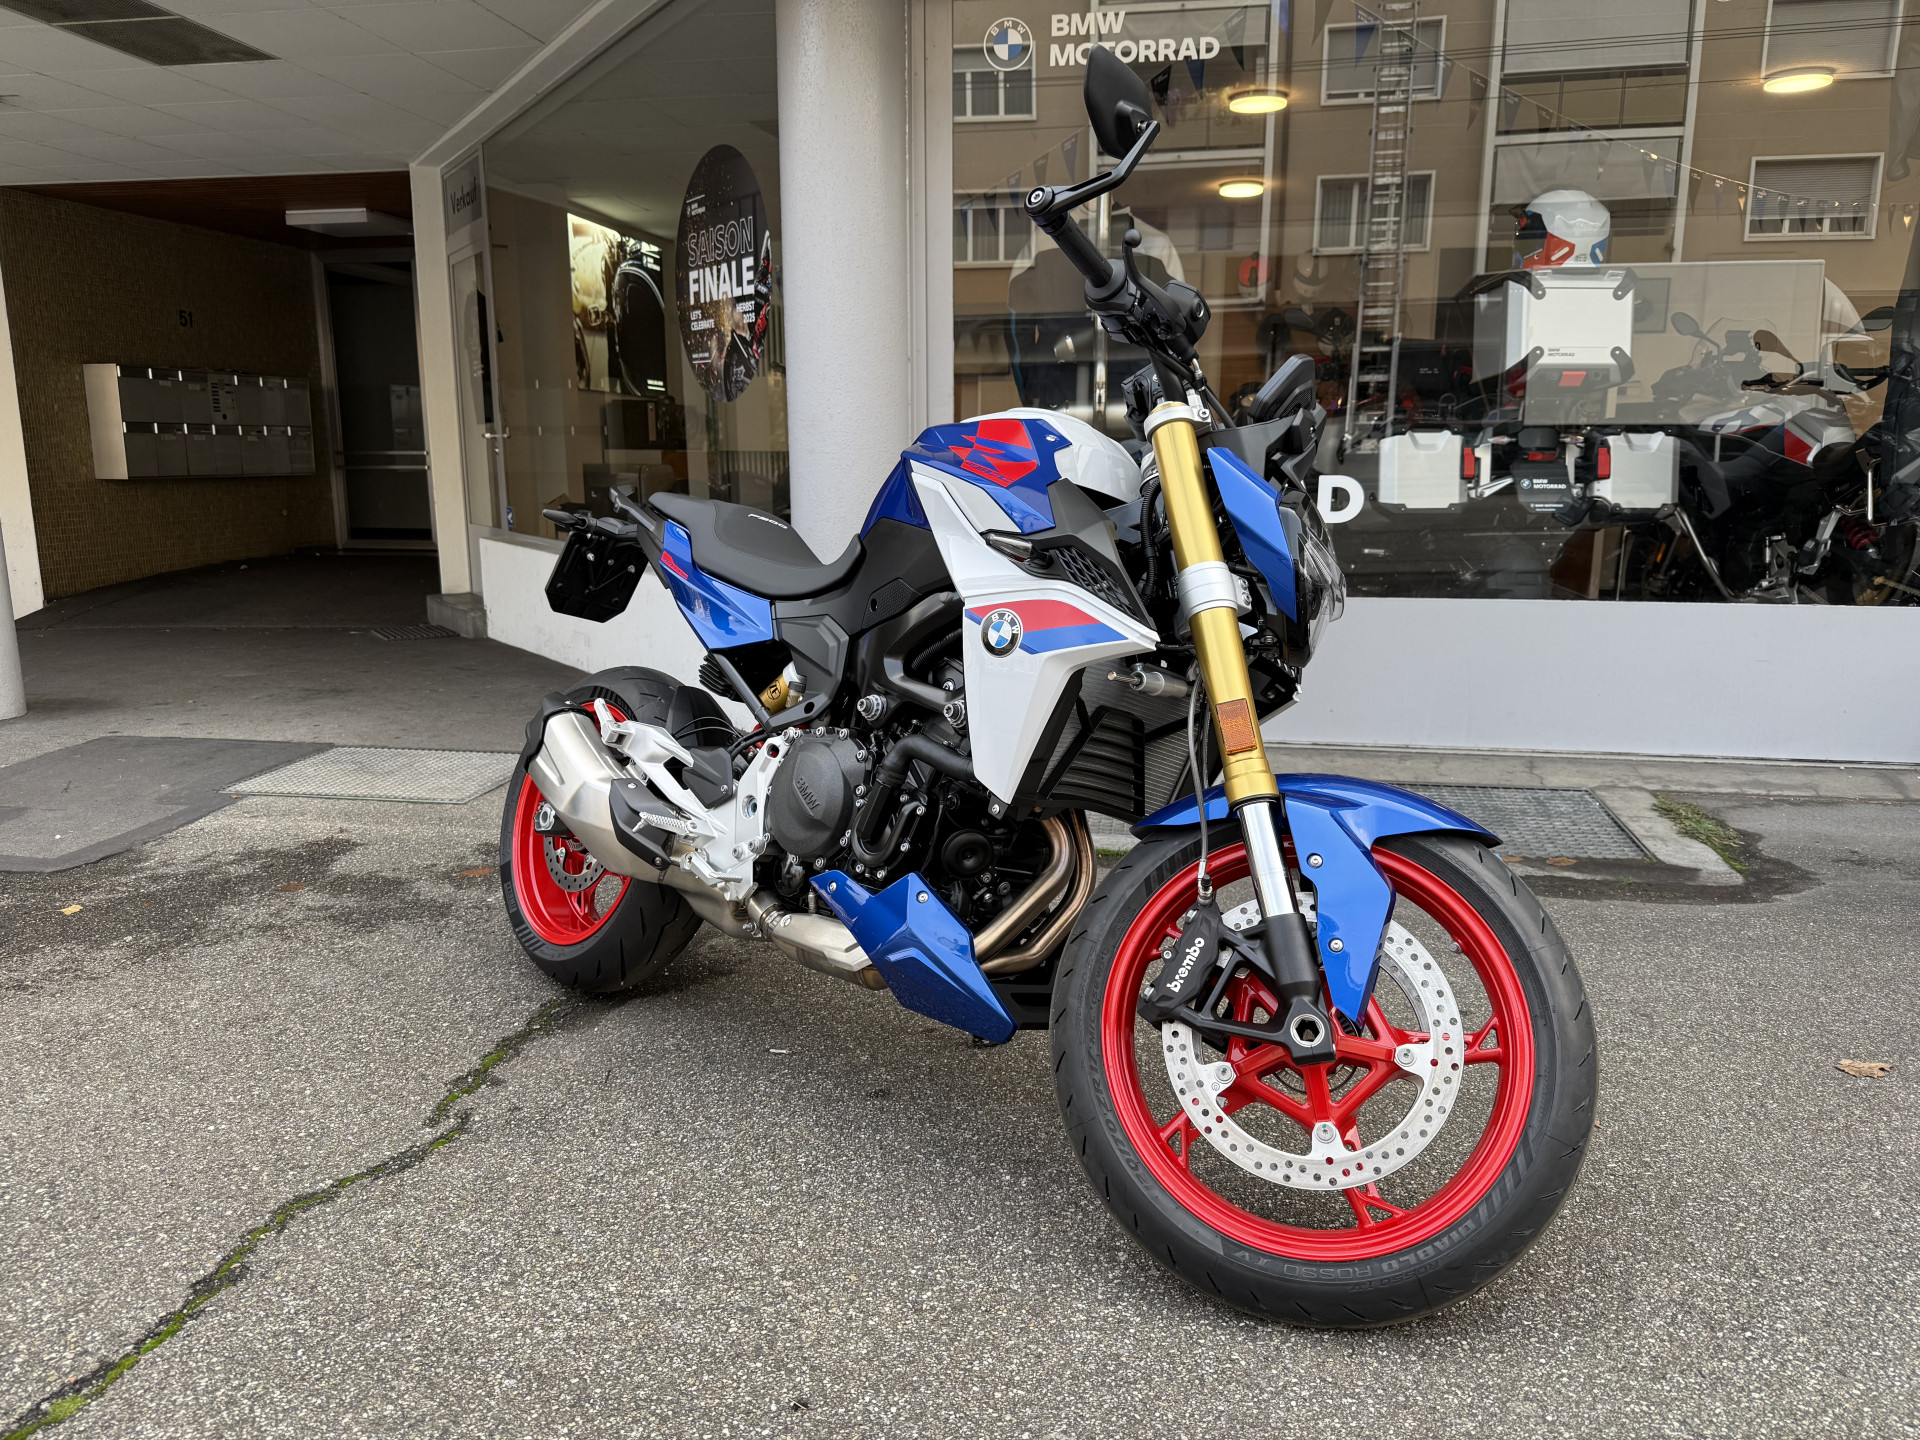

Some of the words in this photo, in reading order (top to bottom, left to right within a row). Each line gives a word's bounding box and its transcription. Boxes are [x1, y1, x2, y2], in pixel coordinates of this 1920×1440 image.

[991, 20, 1026, 37] BMW
[1051, 11, 1125, 37] BMW
[450, 176, 477, 215] Verkauf
[688, 216, 754, 267] SAISON
[688, 256, 755, 306] FINALE
[179, 309, 193, 328] 51
[736, 301, 756, 313] HERBST
[743, 312, 756, 324] 2025
[691, 318, 715, 332] CELEBRATE
[1317, 474, 1365, 523] D
[991, 612, 1020, 634] BMW
[796, 776, 820, 811] BMW
[1166, 937, 1205, 993] brembo
[1380, 1218, 1477, 1273] DIABLO
[1232, 1249, 1271, 1267] IV
[1282, 1263, 1373, 1279] ROSSO
